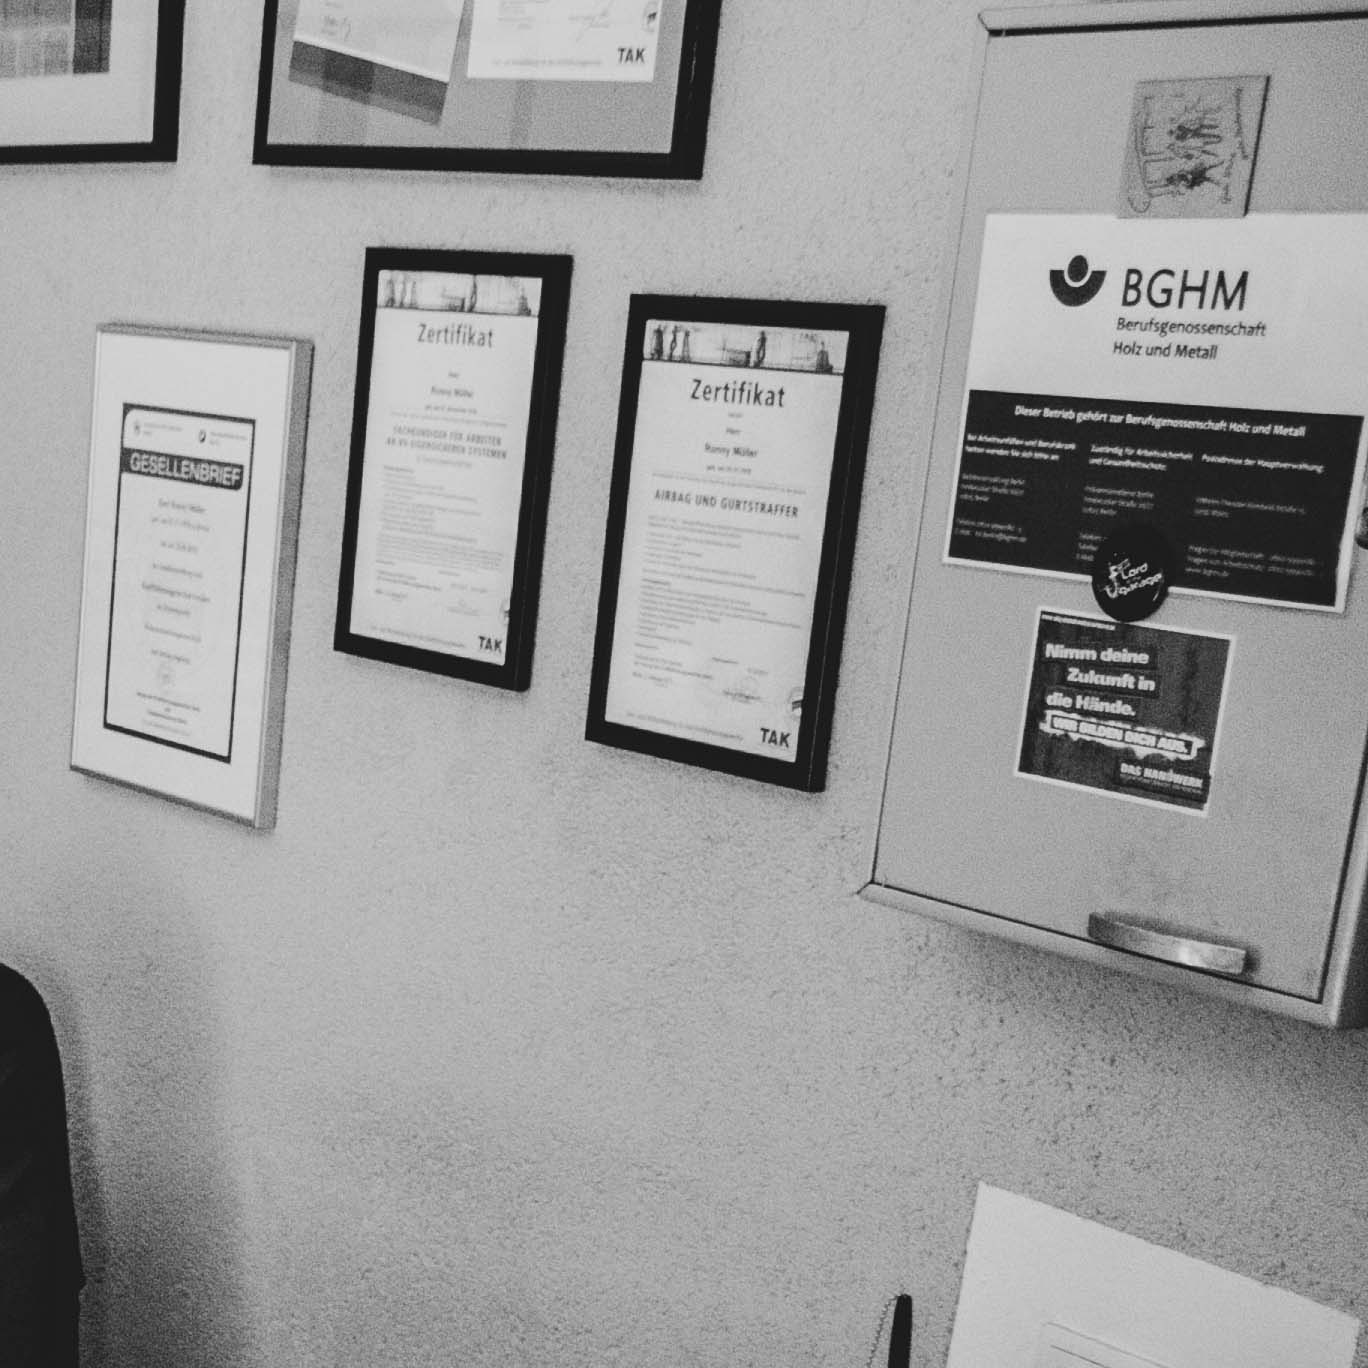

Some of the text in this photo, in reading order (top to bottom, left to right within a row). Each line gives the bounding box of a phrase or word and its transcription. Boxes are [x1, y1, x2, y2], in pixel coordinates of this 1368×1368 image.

[618, 47, 646, 64] TAK
[1121, 268, 1250, 312] BGHM
[417, 322, 494, 349] Zertifikat
[1115, 316, 1267, 338] Berufsgenossenschaft
[1112, 340, 1219, 361] Holz und Metall
[690, 377, 786, 408] Zertifikat
[1125, 412, 1227, 431] Berufsgenossenschaft
[1228, 420, 1251, 434] Holz
[1251, 423, 1273, 436] und
[1272, 424, 1307, 438] Metall
[130, 452, 242, 487] GESELLENBRIEF
[654, 488, 799, 518] AIRBAG UND GURTSTRAFFER
[477, 635, 503, 655] TAK
[1045, 642, 1150, 665] Nimm deine
[1066, 666, 1157, 692] Zukunft in
[1046, 691, 1137, 717] die Hände.
[760, 727, 791, 749] TAK
